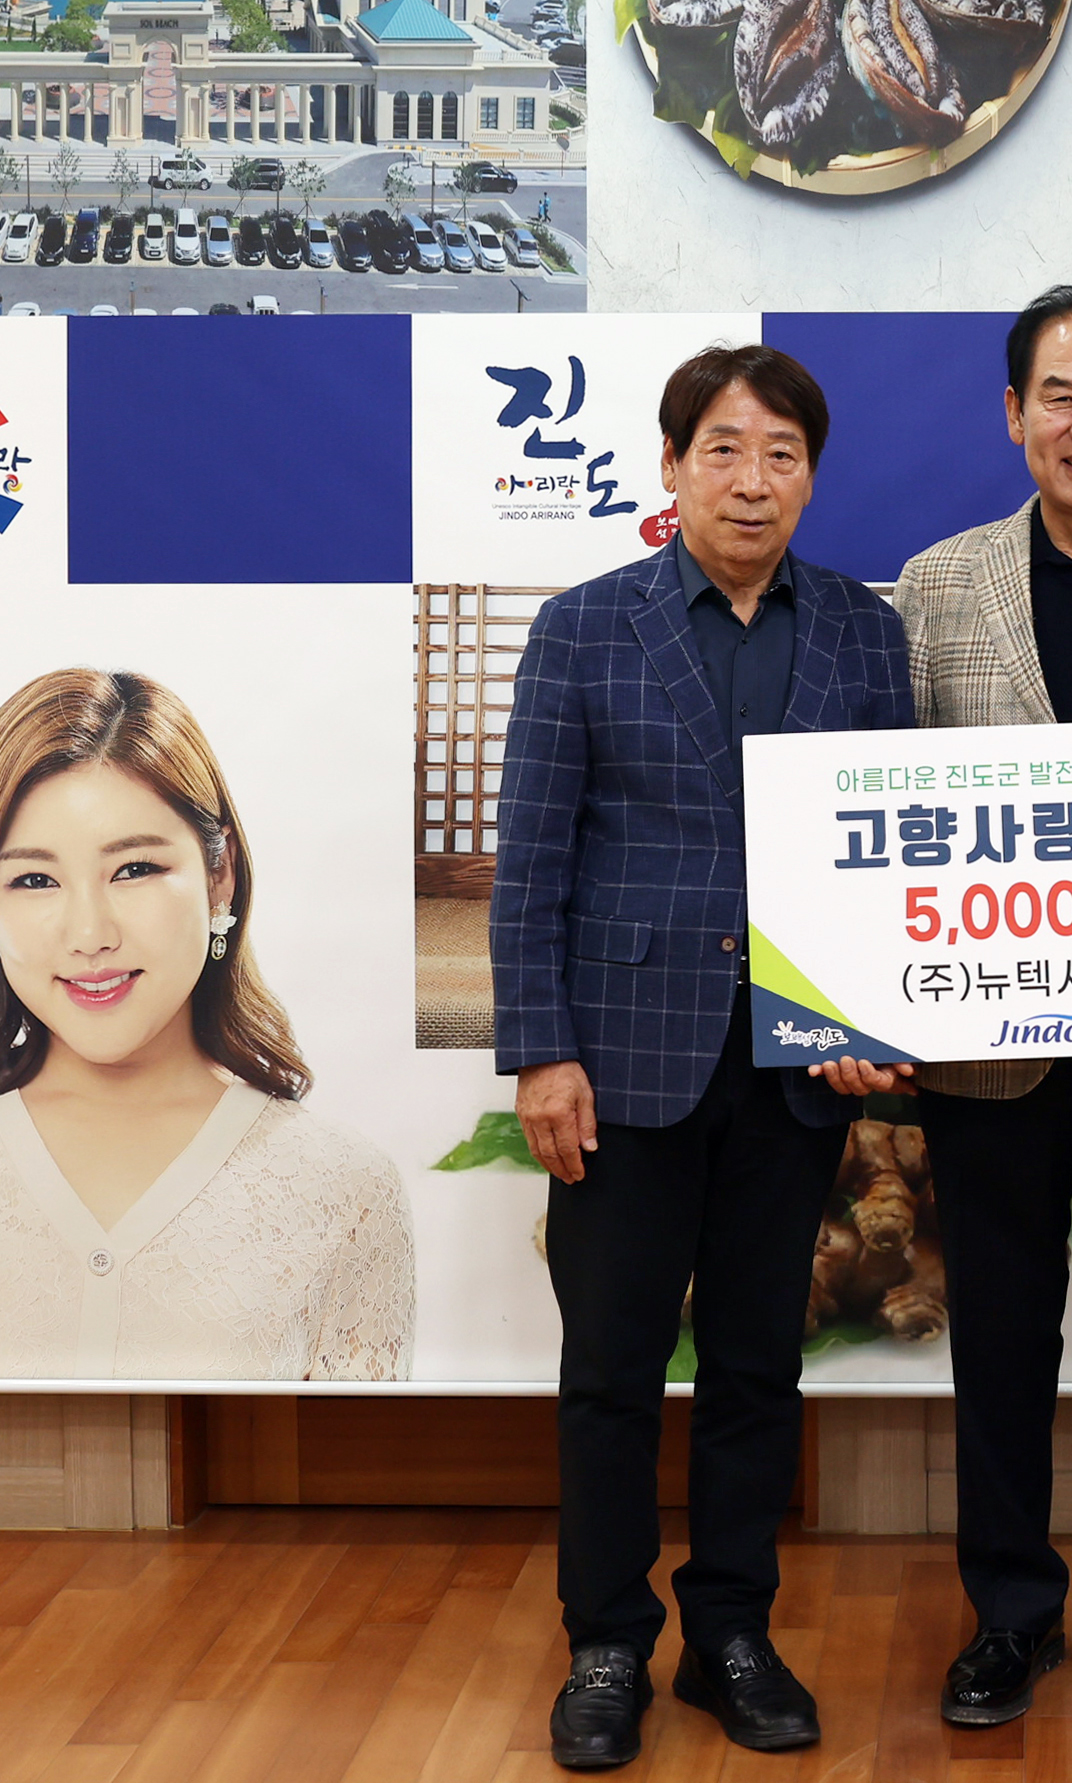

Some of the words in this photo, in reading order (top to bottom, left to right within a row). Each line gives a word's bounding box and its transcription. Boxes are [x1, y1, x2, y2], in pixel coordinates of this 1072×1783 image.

[495, 474, 581, 499] 아리랑
[498, 511, 529, 520] JINDO
[531, 511, 575, 520] ARIRANG
[836, 766, 935, 792] 아름다운
[946, 763, 1020, 789] 진도군
[811, 1028, 848, 1050] 진도
